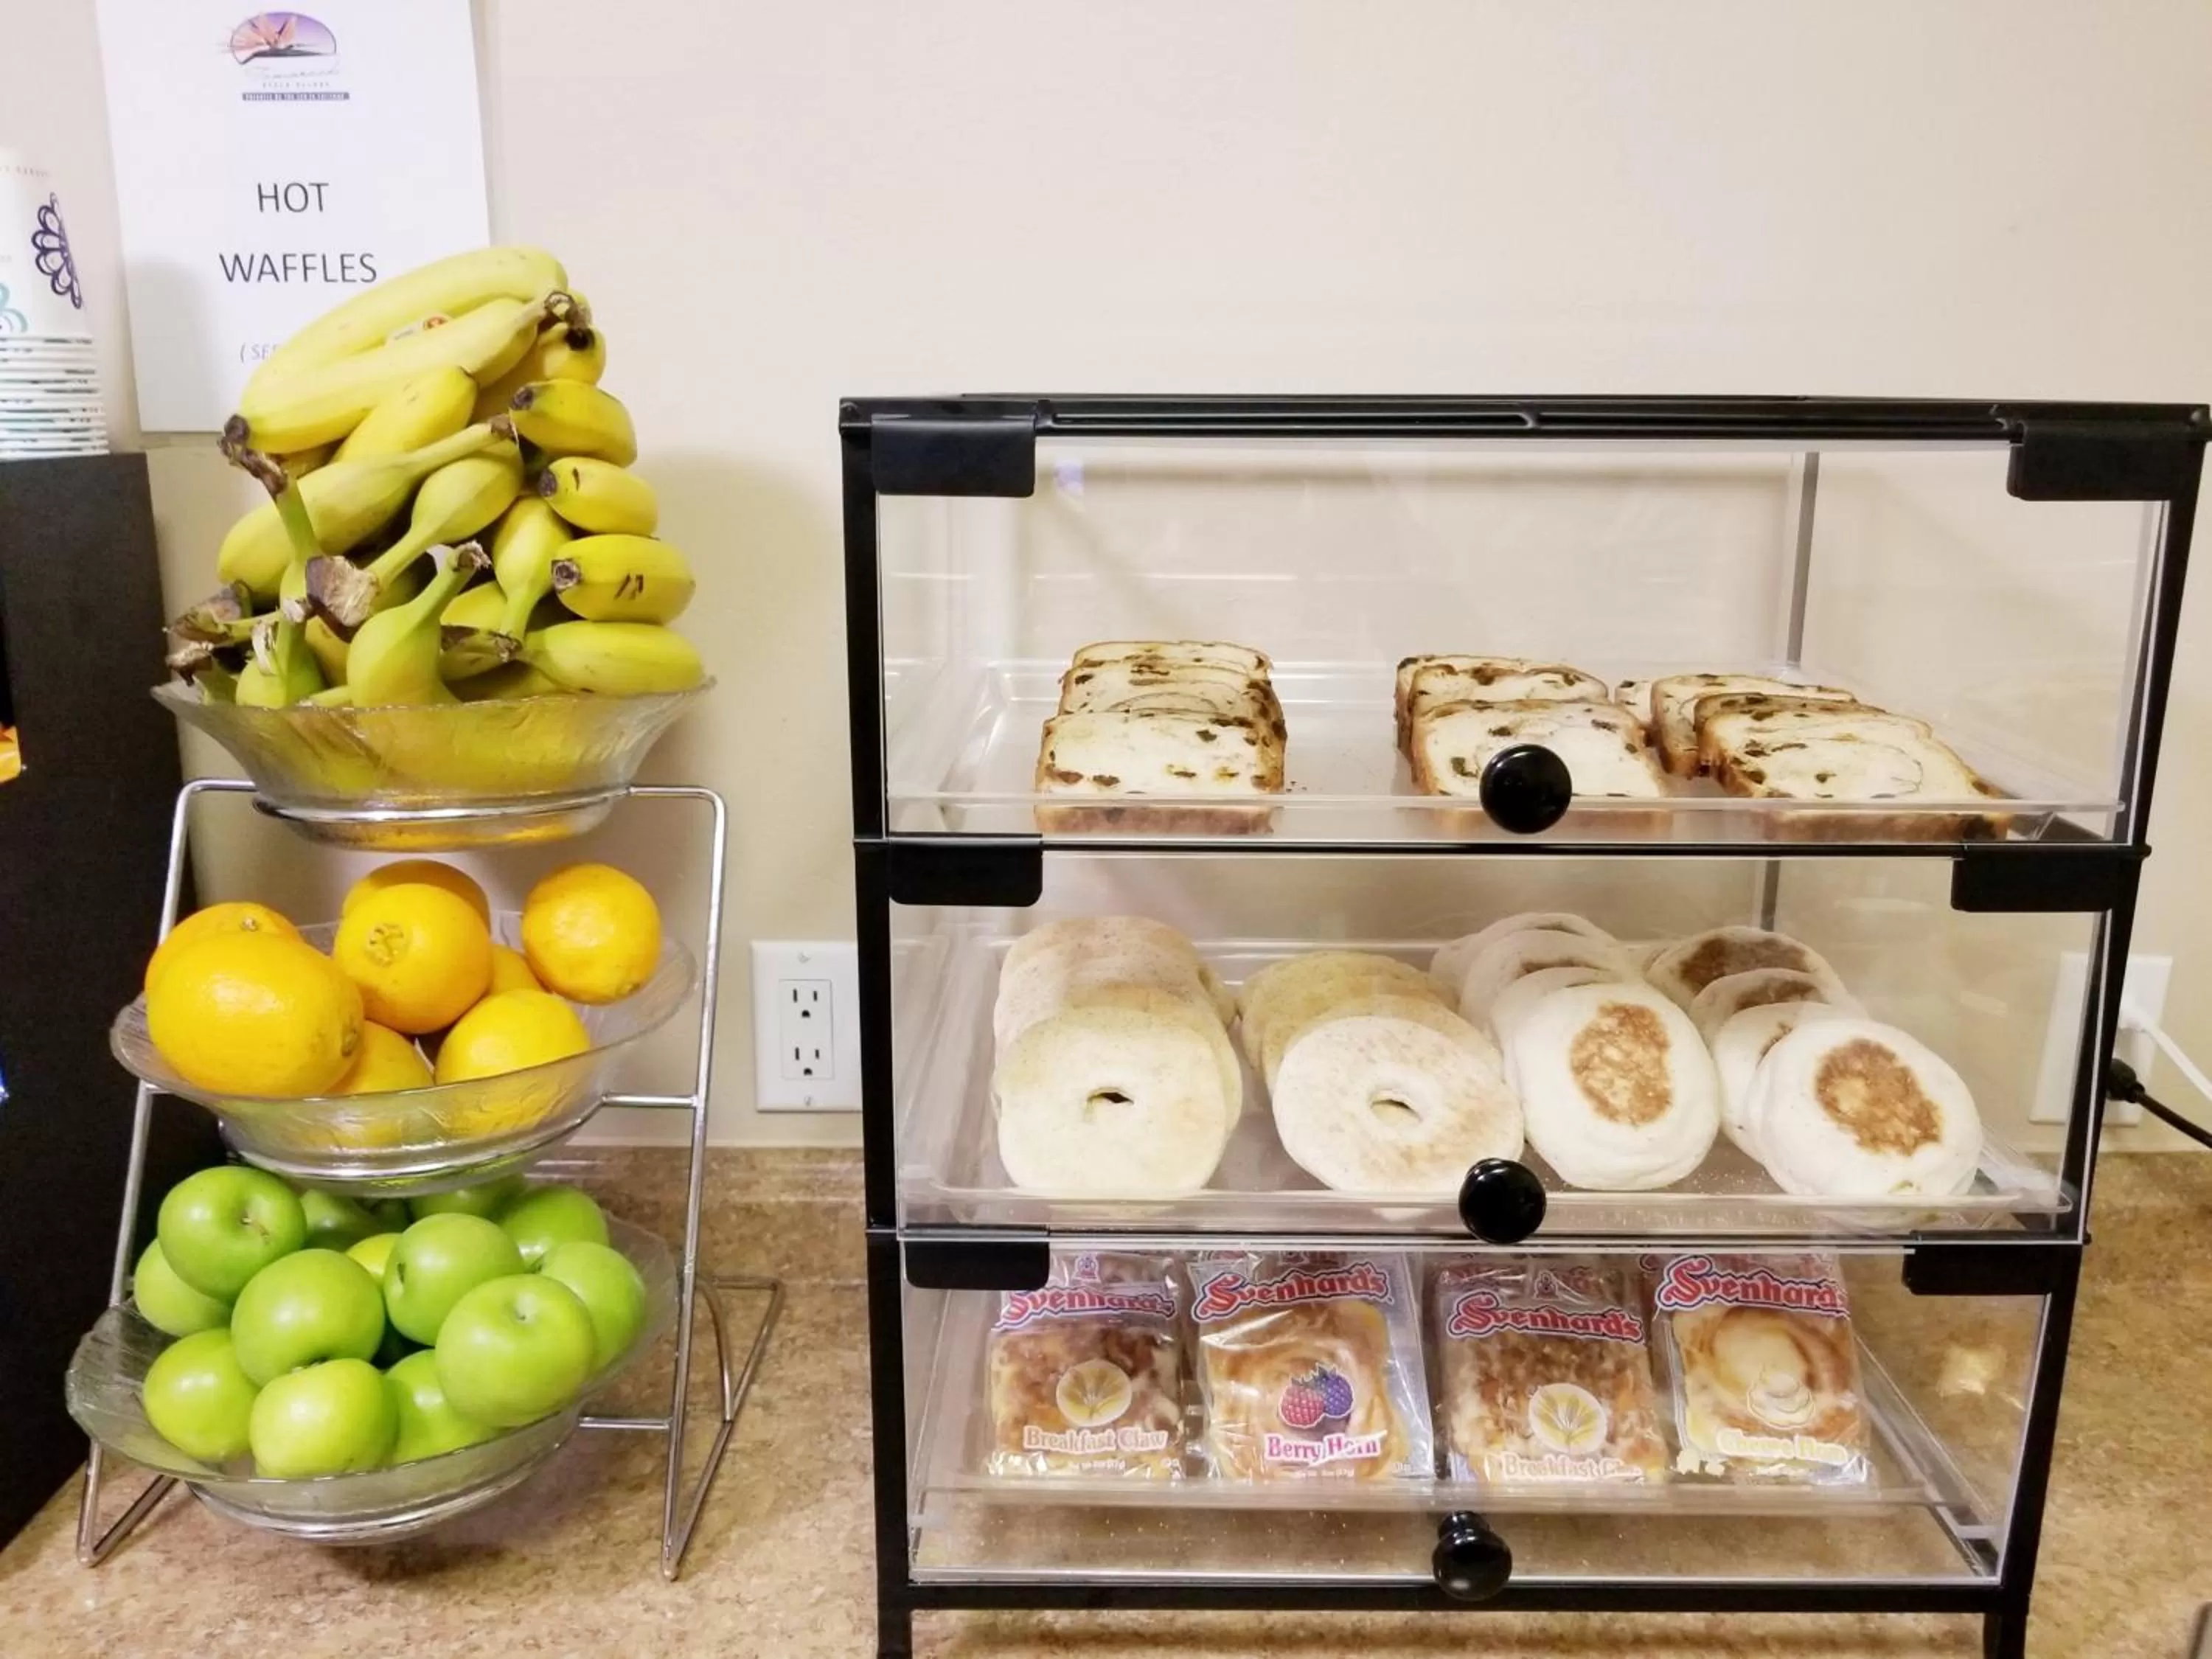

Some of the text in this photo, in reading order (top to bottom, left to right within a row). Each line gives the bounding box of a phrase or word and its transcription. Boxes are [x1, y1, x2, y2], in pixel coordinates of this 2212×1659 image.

[257, 182, 329, 213] HOT
[219, 253, 378, 283] WAFFLES
[1196, 1264, 1388, 1318] Svenhard's
[1451, 1293, 1644, 1341] Svenhard's
[1026, 1427, 1166, 1453] Breakfast Claw
[1267, 1436, 1378, 1461] Berry Horn
